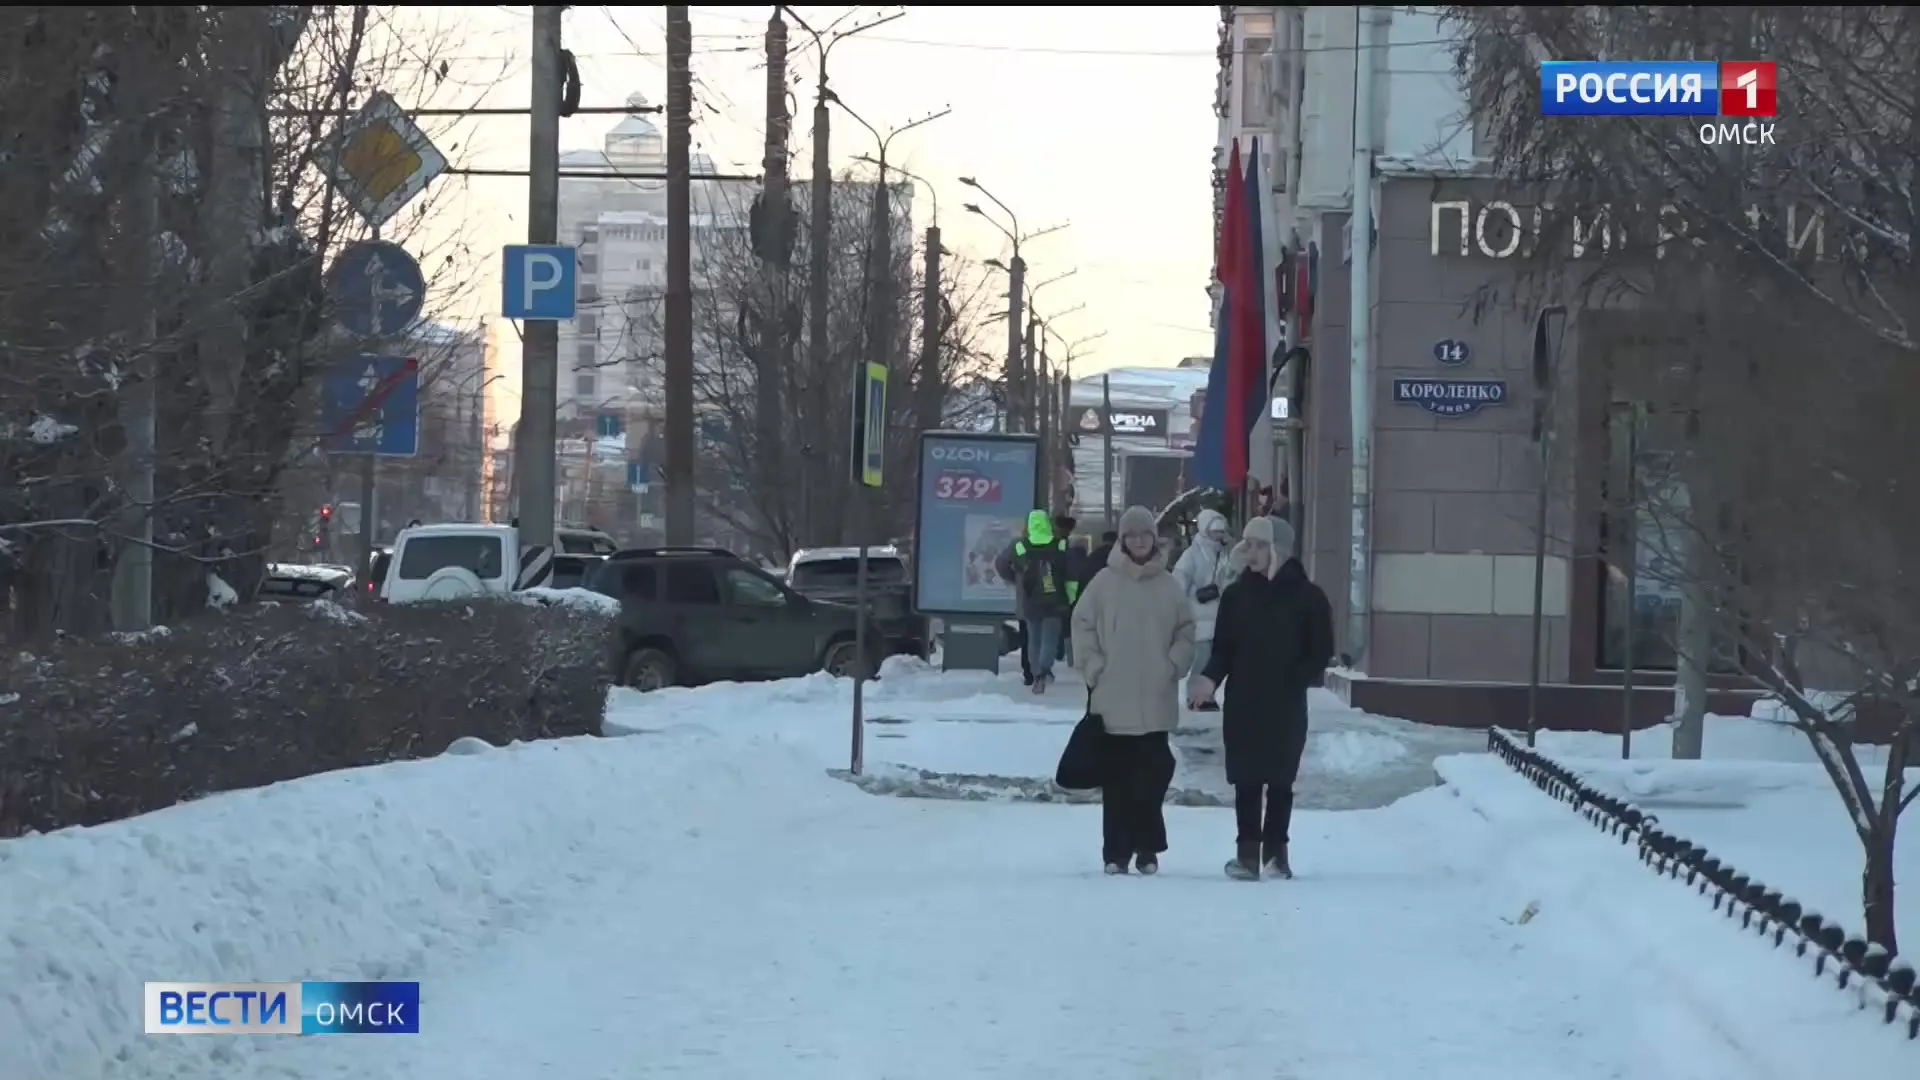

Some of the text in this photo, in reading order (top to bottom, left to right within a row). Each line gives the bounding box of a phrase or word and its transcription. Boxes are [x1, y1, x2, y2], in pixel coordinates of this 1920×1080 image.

[523, 253, 563, 310] P
[1440, 344, 1463, 361] 14
[1400, 383, 1502, 400] КОРОЛЕНКО
[932, 446, 990, 462] OZON
